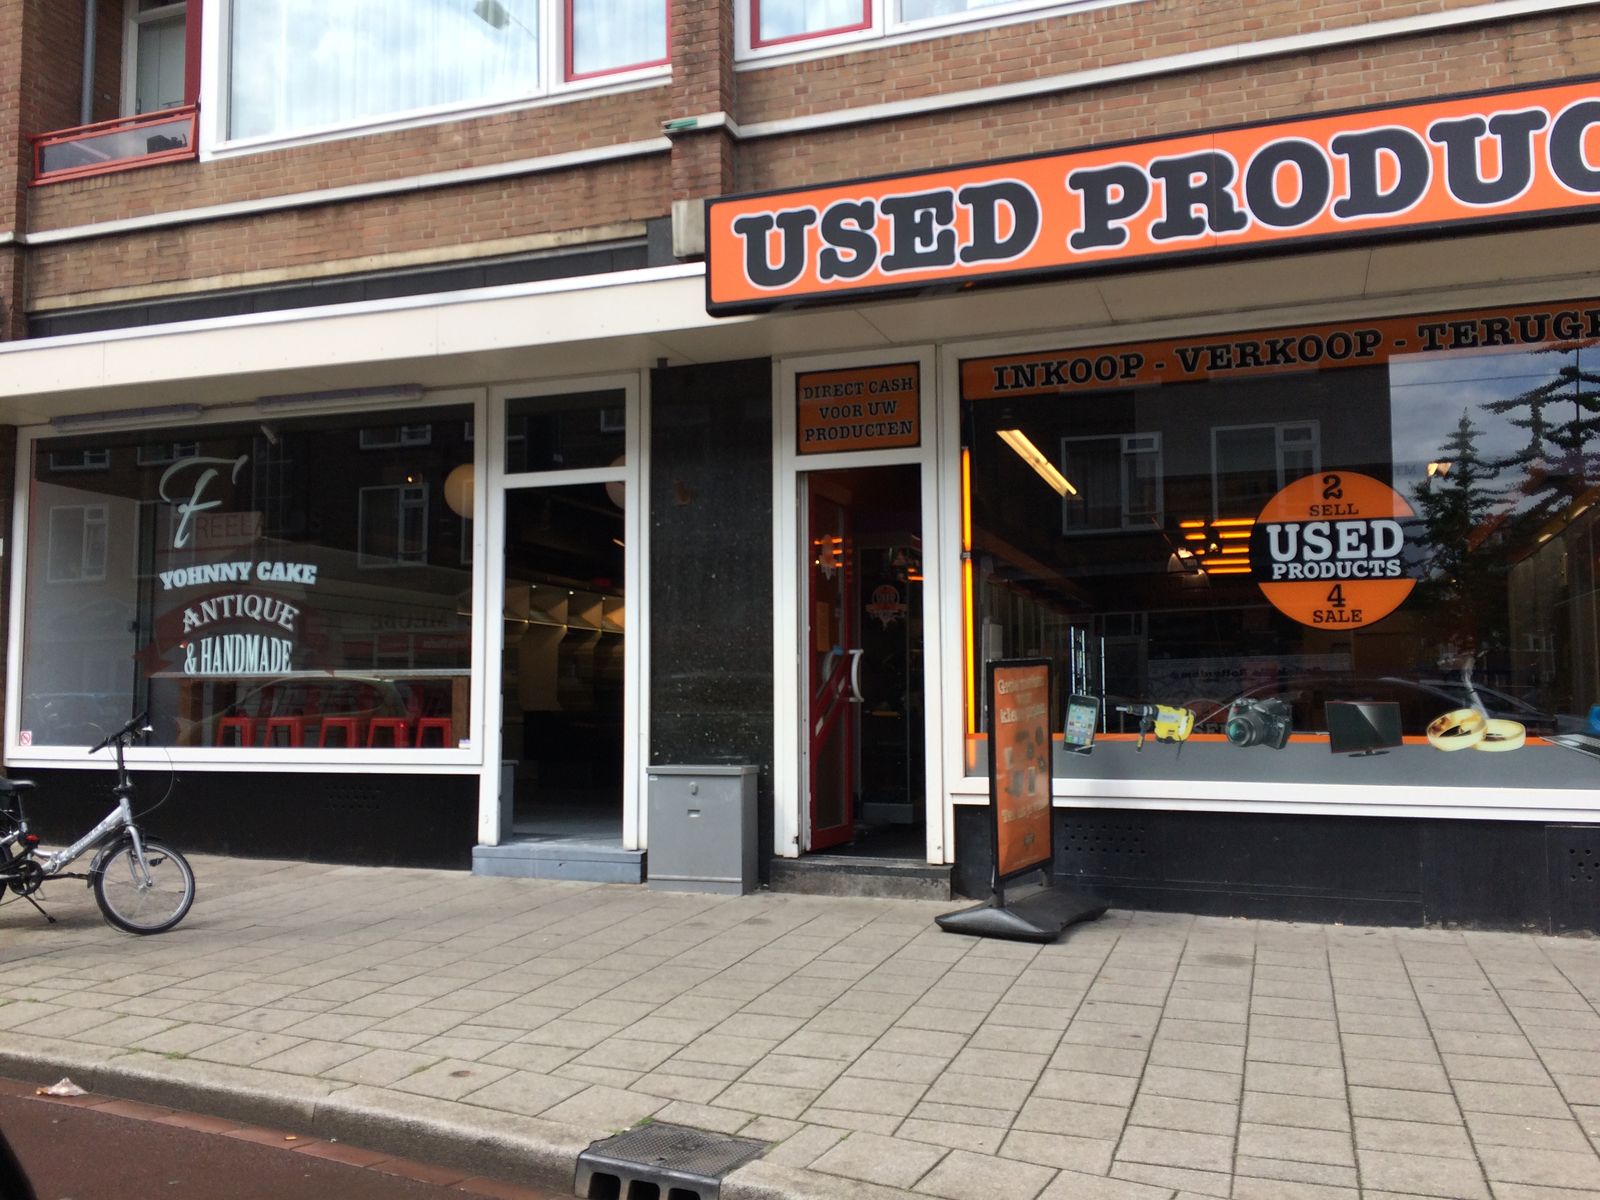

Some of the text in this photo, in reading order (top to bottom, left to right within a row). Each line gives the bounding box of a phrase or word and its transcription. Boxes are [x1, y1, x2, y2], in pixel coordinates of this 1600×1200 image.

[732, 180, 1042, 290] USED
[993, 352, 1144, 391] INKOOP
[1175, 329, 1382, 373] VERKOOP
[803, 377, 913, 400] DIRECT CASH
[819, 400, 897, 420] VOOR UW
[804, 421, 913, 442] PRODUCTEN
[1322, 474, 1344, 501] 2
[1309, 502, 1360, 518] SELL
[1265, 519, 1405, 563] USED
[159, 561, 318, 591] YOHNNY CAKE
[1271, 559, 1402, 580] PRODUCTS
[1327, 584, 1347, 608] 4
[183, 593, 300, 634] ANTIQUE
[1312, 608, 1363, 624] SALE
[183, 633, 293, 676] & HANDMADE
